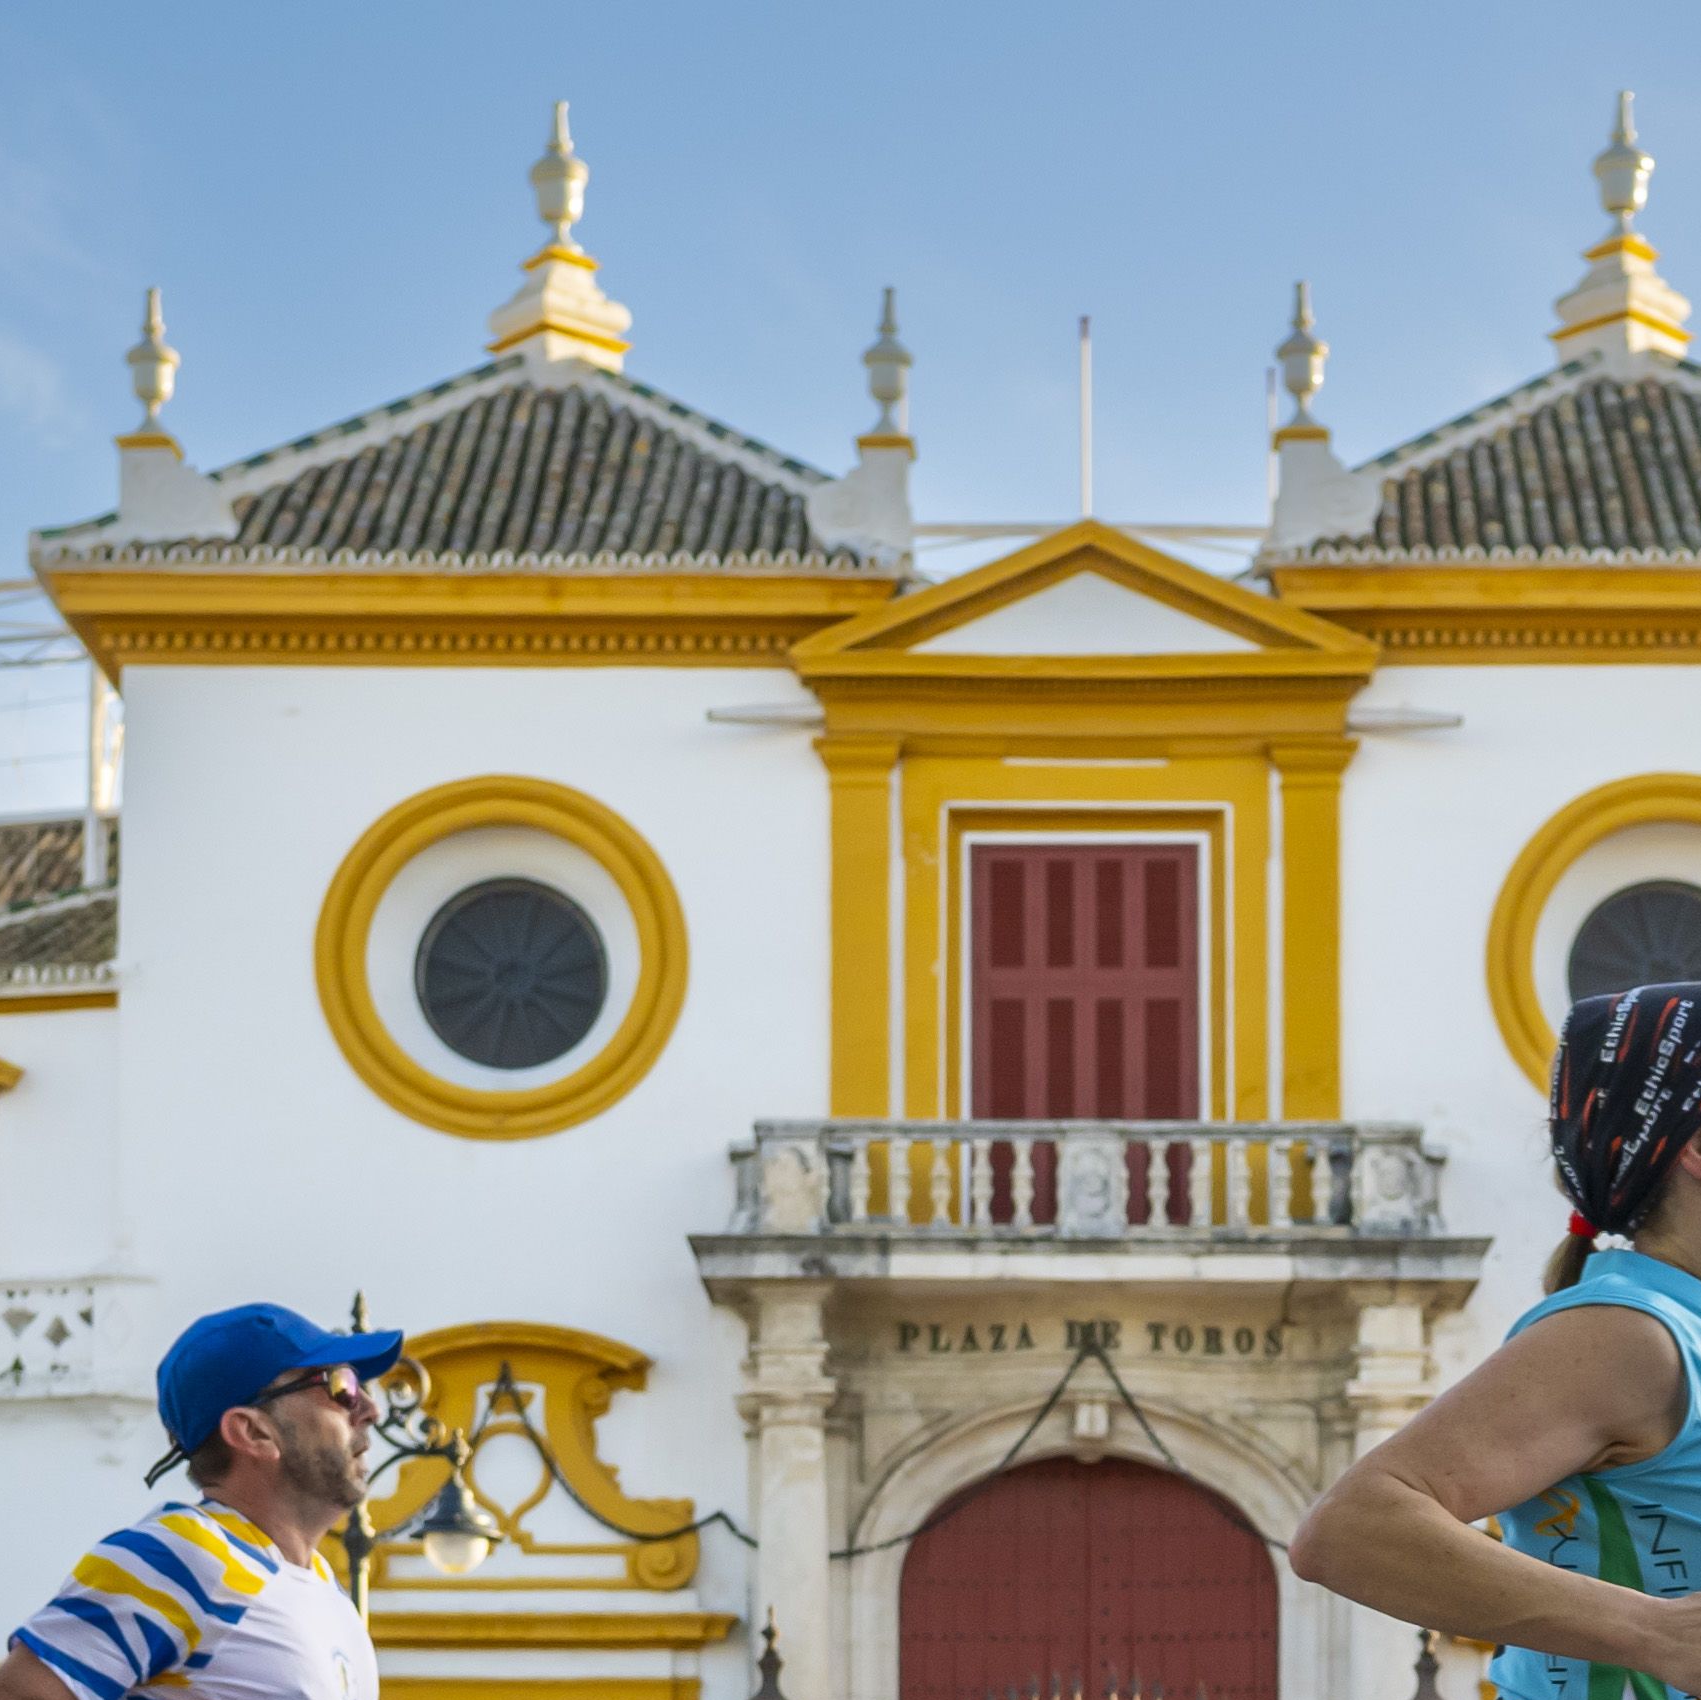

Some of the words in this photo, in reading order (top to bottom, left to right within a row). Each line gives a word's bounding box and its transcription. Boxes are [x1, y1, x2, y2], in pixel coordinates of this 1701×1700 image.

[1634, 999, 1695, 1117] EthicSport
[899, 1320, 1035, 1352] PLAZA
[1063, 1319, 1123, 1350] DE
[1146, 1321, 1284, 1358] TOROS
